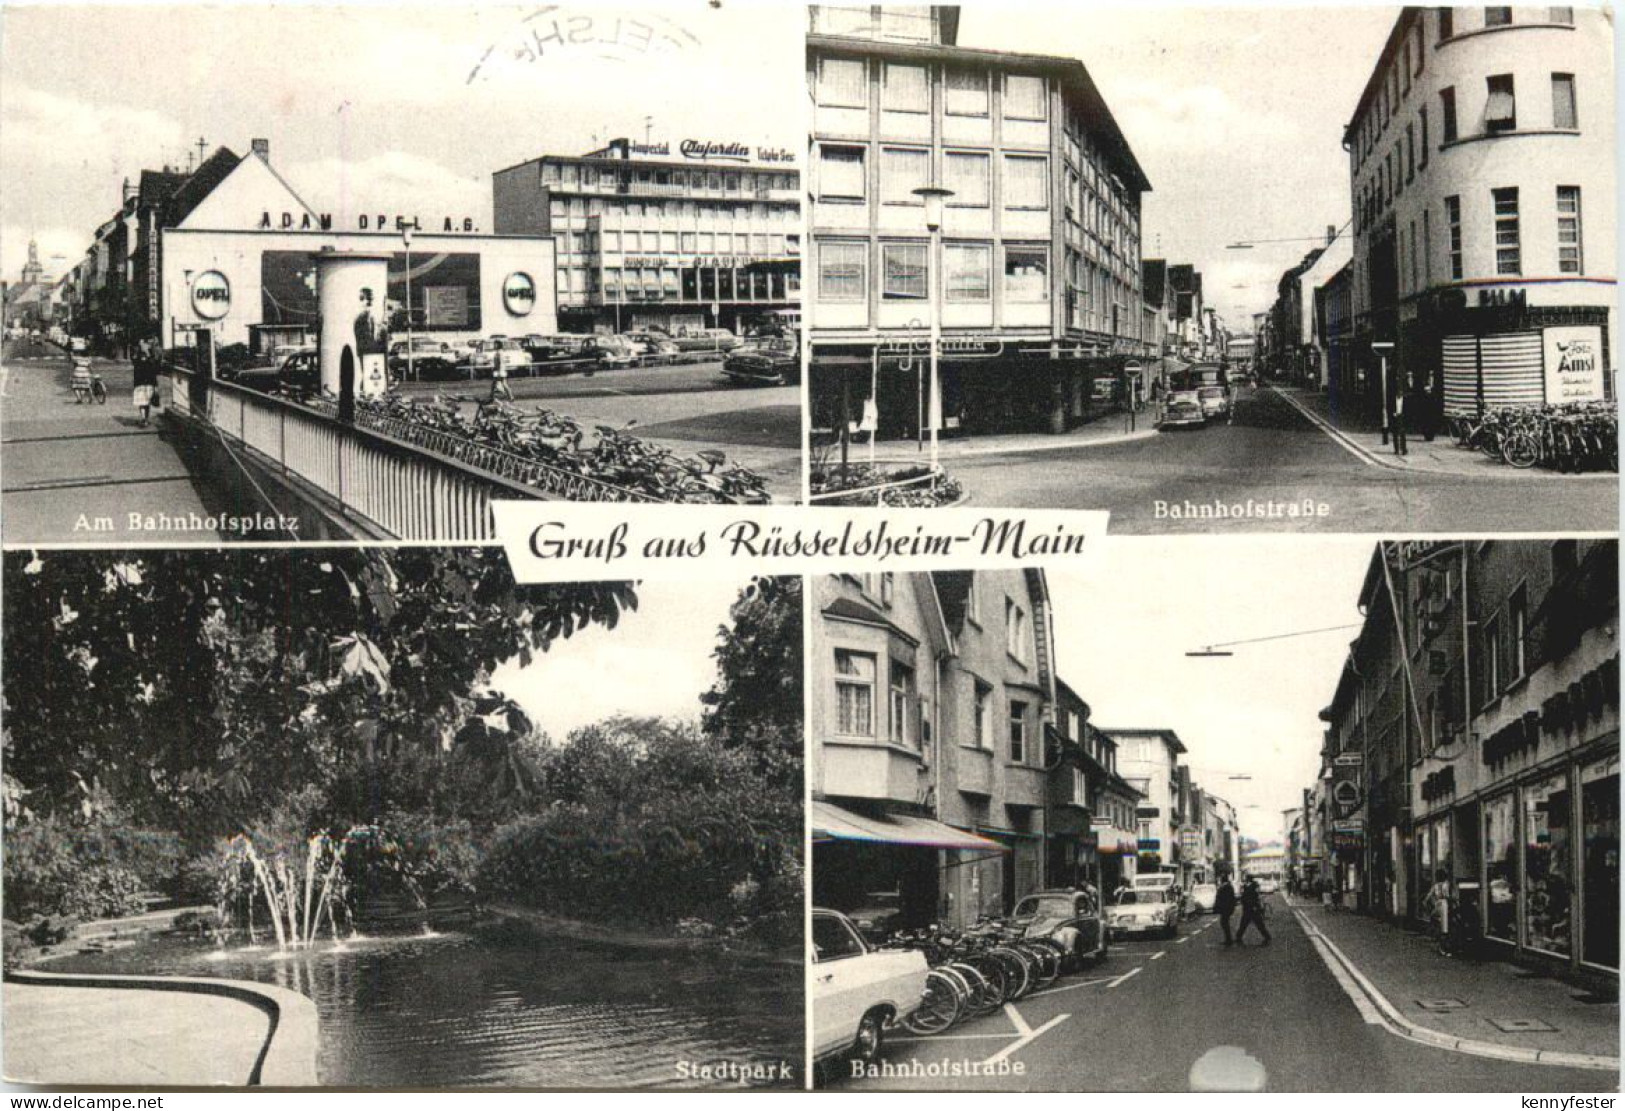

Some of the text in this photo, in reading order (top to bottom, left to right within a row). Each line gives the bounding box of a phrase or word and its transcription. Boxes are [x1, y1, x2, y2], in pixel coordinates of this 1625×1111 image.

[680, 138, 750, 162] Dujardin
[260, 211, 480, 232] ADAM OPEL A.G.
[196, 288, 229, 302] OPEL
